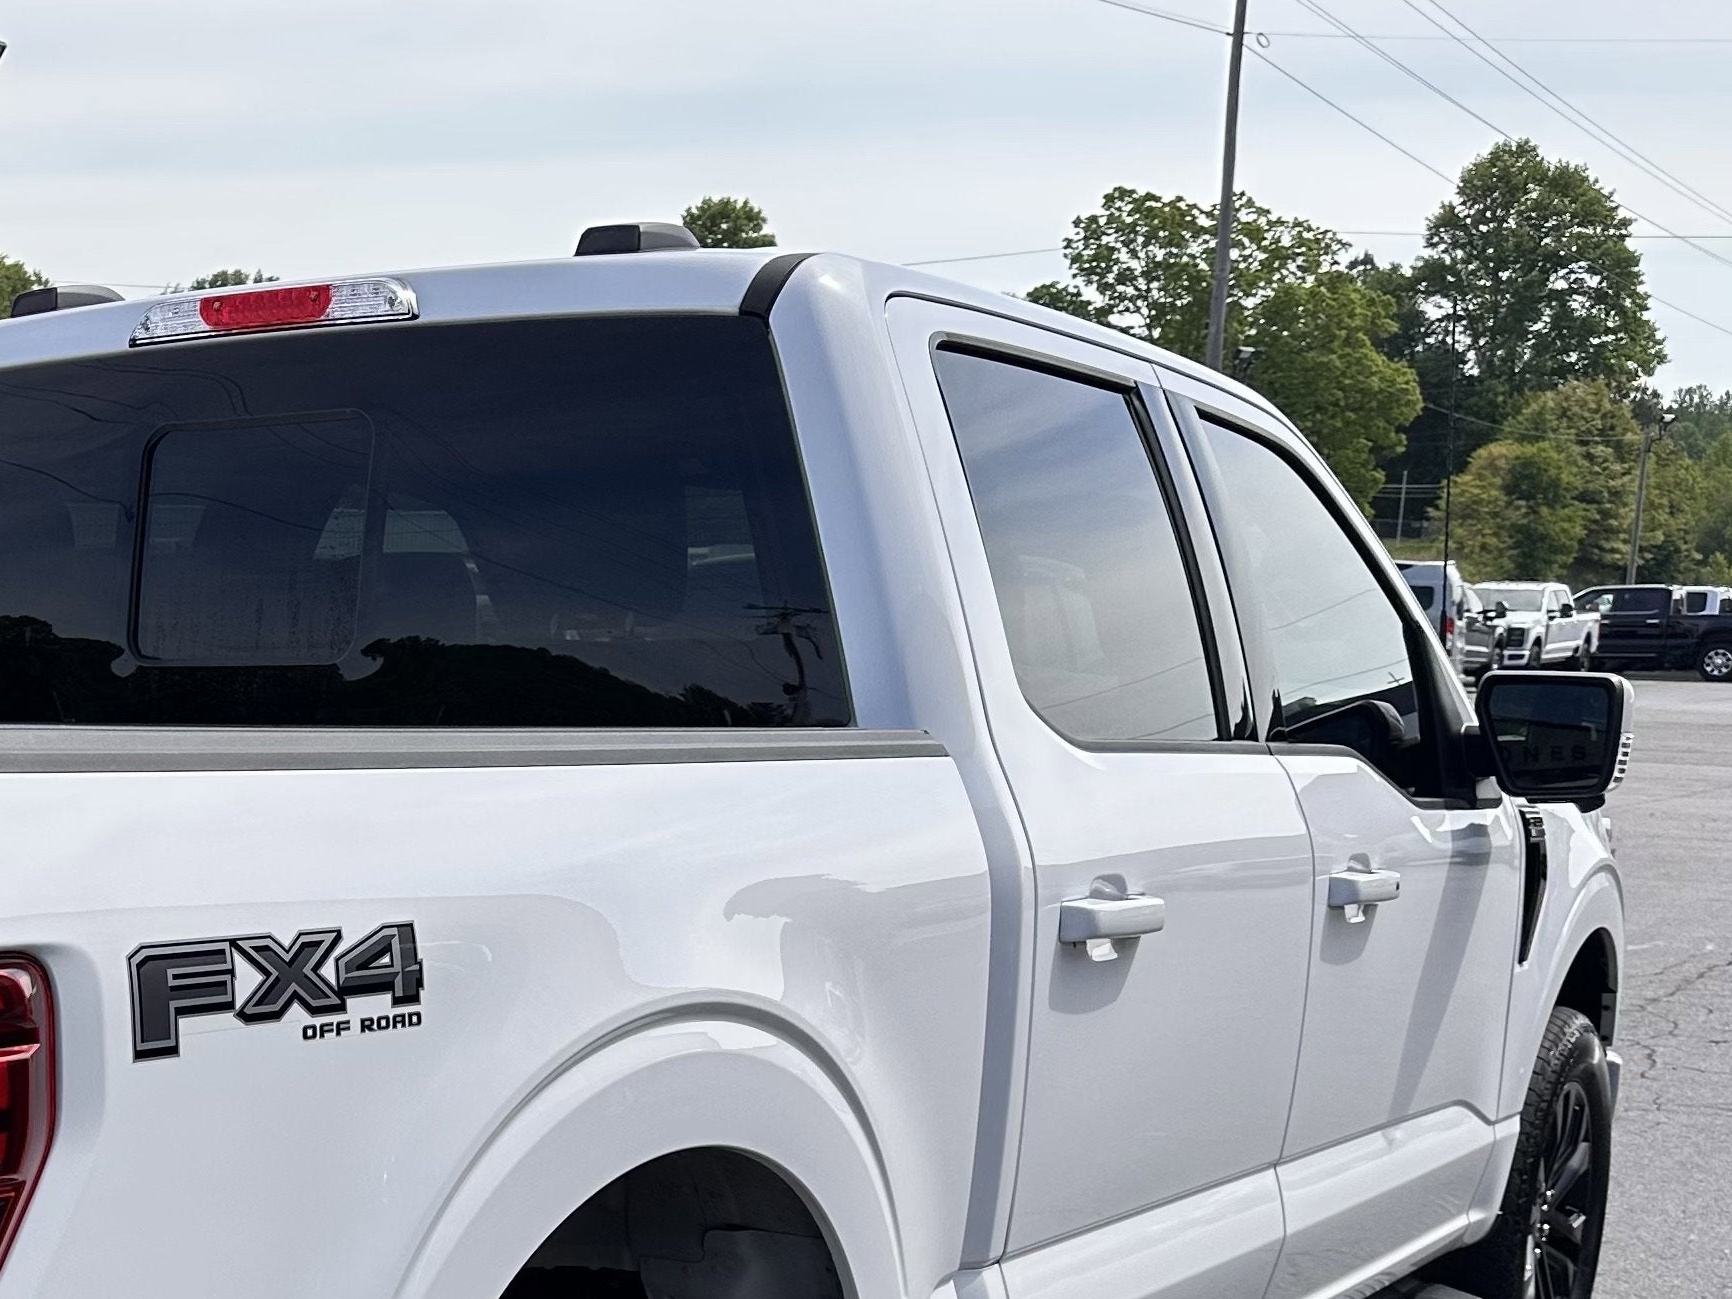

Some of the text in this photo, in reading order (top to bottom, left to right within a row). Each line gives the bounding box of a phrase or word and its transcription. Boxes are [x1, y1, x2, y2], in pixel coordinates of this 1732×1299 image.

[125, 919, 425, 1063] FX4
[302, 1010, 422, 1041] OFF ROAD
